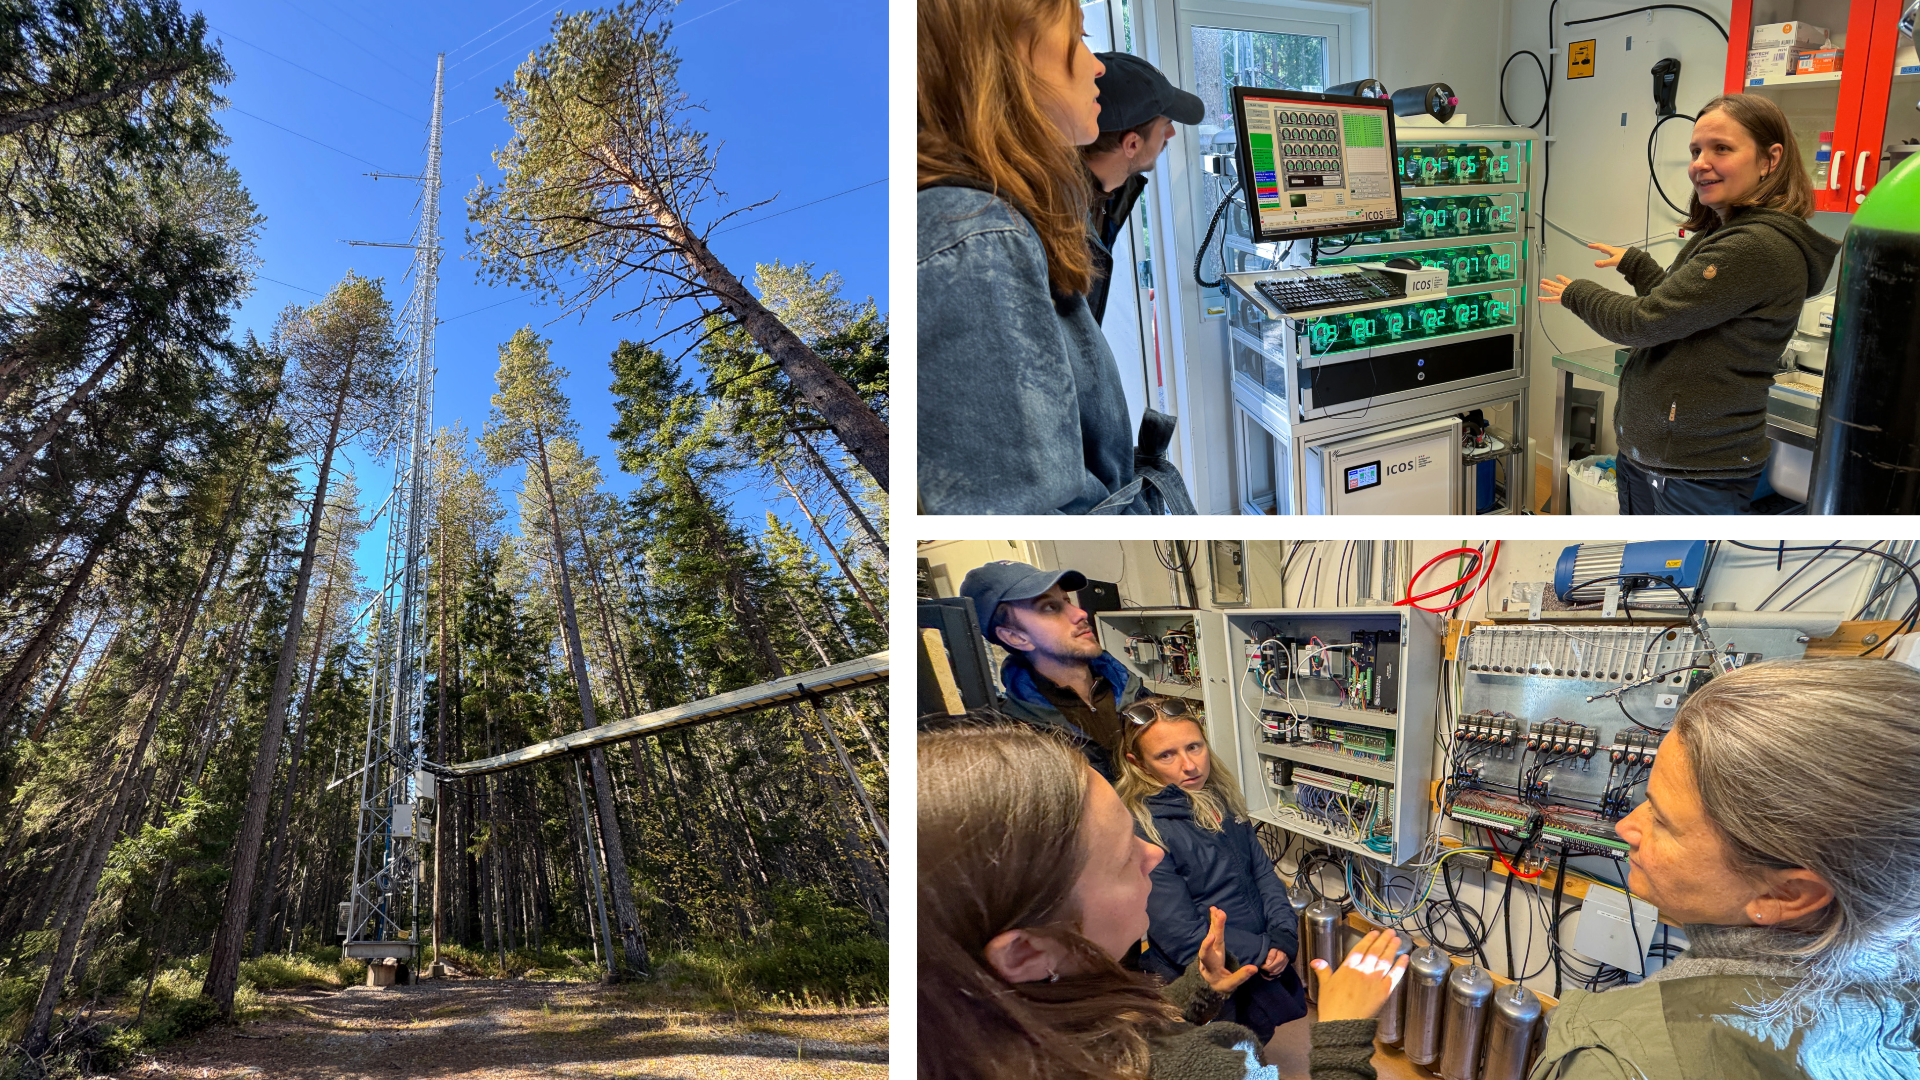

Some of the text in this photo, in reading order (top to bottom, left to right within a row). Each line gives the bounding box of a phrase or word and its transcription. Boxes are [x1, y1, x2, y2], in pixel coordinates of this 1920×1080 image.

[1432, 157, 1441, 173] 4
[1467, 156, 1476, 173] 5
[1500, 155, 1509, 172] 6
[1365, 210, 1384, 221] ICOS
[1433, 209, 1446, 227] 10
[1500, 205, 1512, 222] 12
[1467, 257, 1479, 273] 17
[1498, 253, 1510, 270] 18
[1412, 279, 1431, 291] ICOS
[1428, 309, 1446, 327] 22
[1461, 304, 1479, 322] 23
[1492, 300, 1510, 317] 24
[1386, 460, 1414, 476] ICOS
